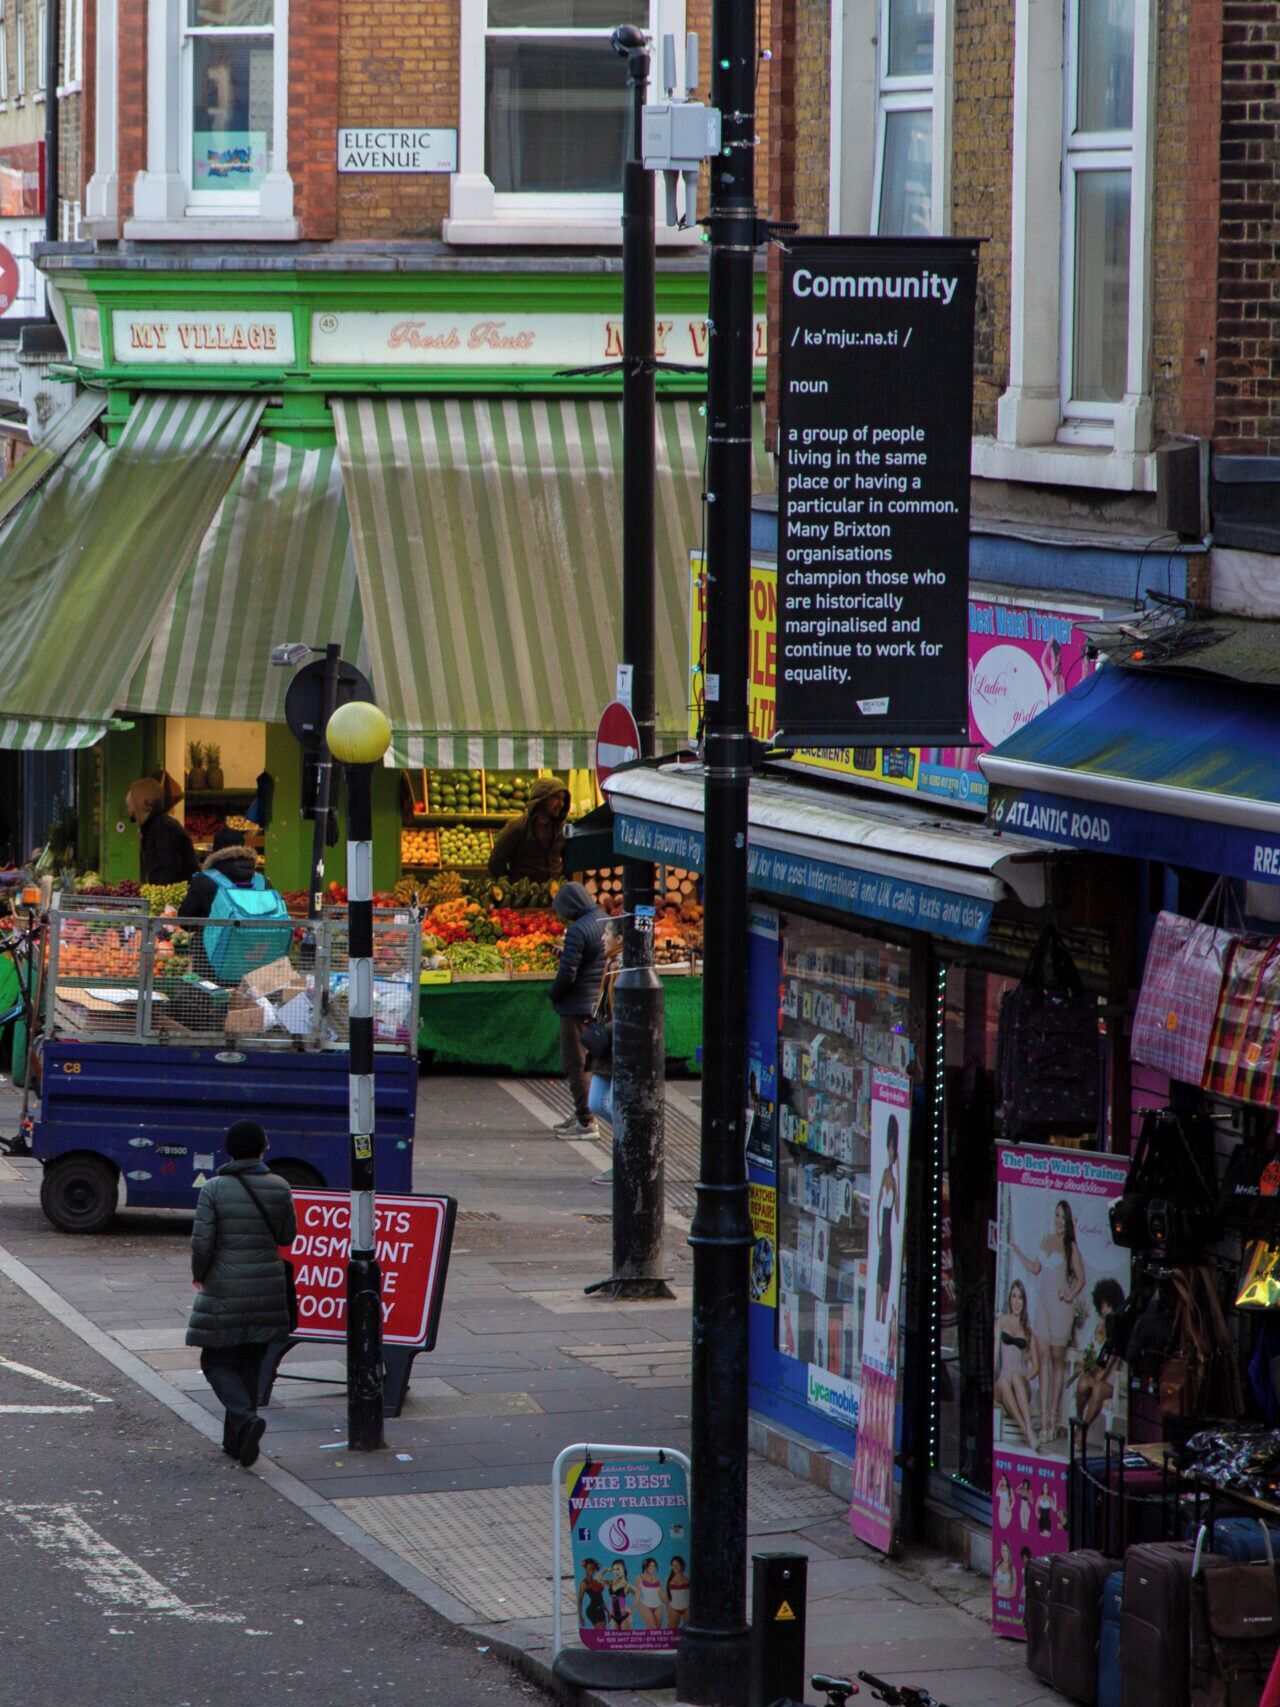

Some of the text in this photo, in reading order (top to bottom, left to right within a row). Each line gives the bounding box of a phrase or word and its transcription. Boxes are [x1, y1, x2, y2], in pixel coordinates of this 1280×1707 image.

[344, 132, 431, 149] ELECTRIC
[344, 151, 421, 168] AVENUE
[792, 269, 958, 305] Community
[322, 319, 335, 328] 45
[130, 323, 168, 349] MY
[178, 323, 277, 350] VILLAGE
[387, 321, 536, 350] Fresh Fruit
[789, 380, 829, 393] noun
[788, 425, 925, 444] a group of people
[788, 449, 927, 468] living in the same
[787, 473, 921, 492] place or having a
[787, 497, 959, 516] particular in common.
[787, 521, 891, 541] Many Brixton
[786, 545, 892, 564] organisations
[786, 569, 946, 588] champion those who
[785, 593, 903, 612] are historically
[785, 617, 920, 636] marginalised and
[970, 603, 1073, 645] Best Waist Trainer
[785, 640, 943, 657] continue to work for
[784, 665, 852, 684] equality.
[974, 672, 1008, 705] Ladies
[1006, 800, 1068, 835] ATLANTIC
[1070, 813, 1111, 843] ROAD
[620, 819, 634, 844] The
[653, 831, 687, 858] favourite
[687, 836, 702, 865] Pay
[758, 859, 771, 877] for
[772, 856, 787, 881] low
[787, 864, 807, 886] cost
[808, 863, 860, 898] International
[861, 881, 876, 902] and
[877, 881, 890, 908] UK
[919, 891, 941, 920] texts
[942, 903, 961, 924] and
[63, 1062, 82, 1074] C8
[1001, 1151, 1128, 1184] The Best Waist Trainer
[304, 1205, 411, 1233] CYCSTS
[290, 1234, 414, 1264] DISMUNT
[295, 1265, 345, 1288] AND
[809, 1374, 859, 1416] Lycamobile
[581, 1474, 672, 1491] THE BEST
[570, 1494, 687, 1511] WAIST TRAINER
